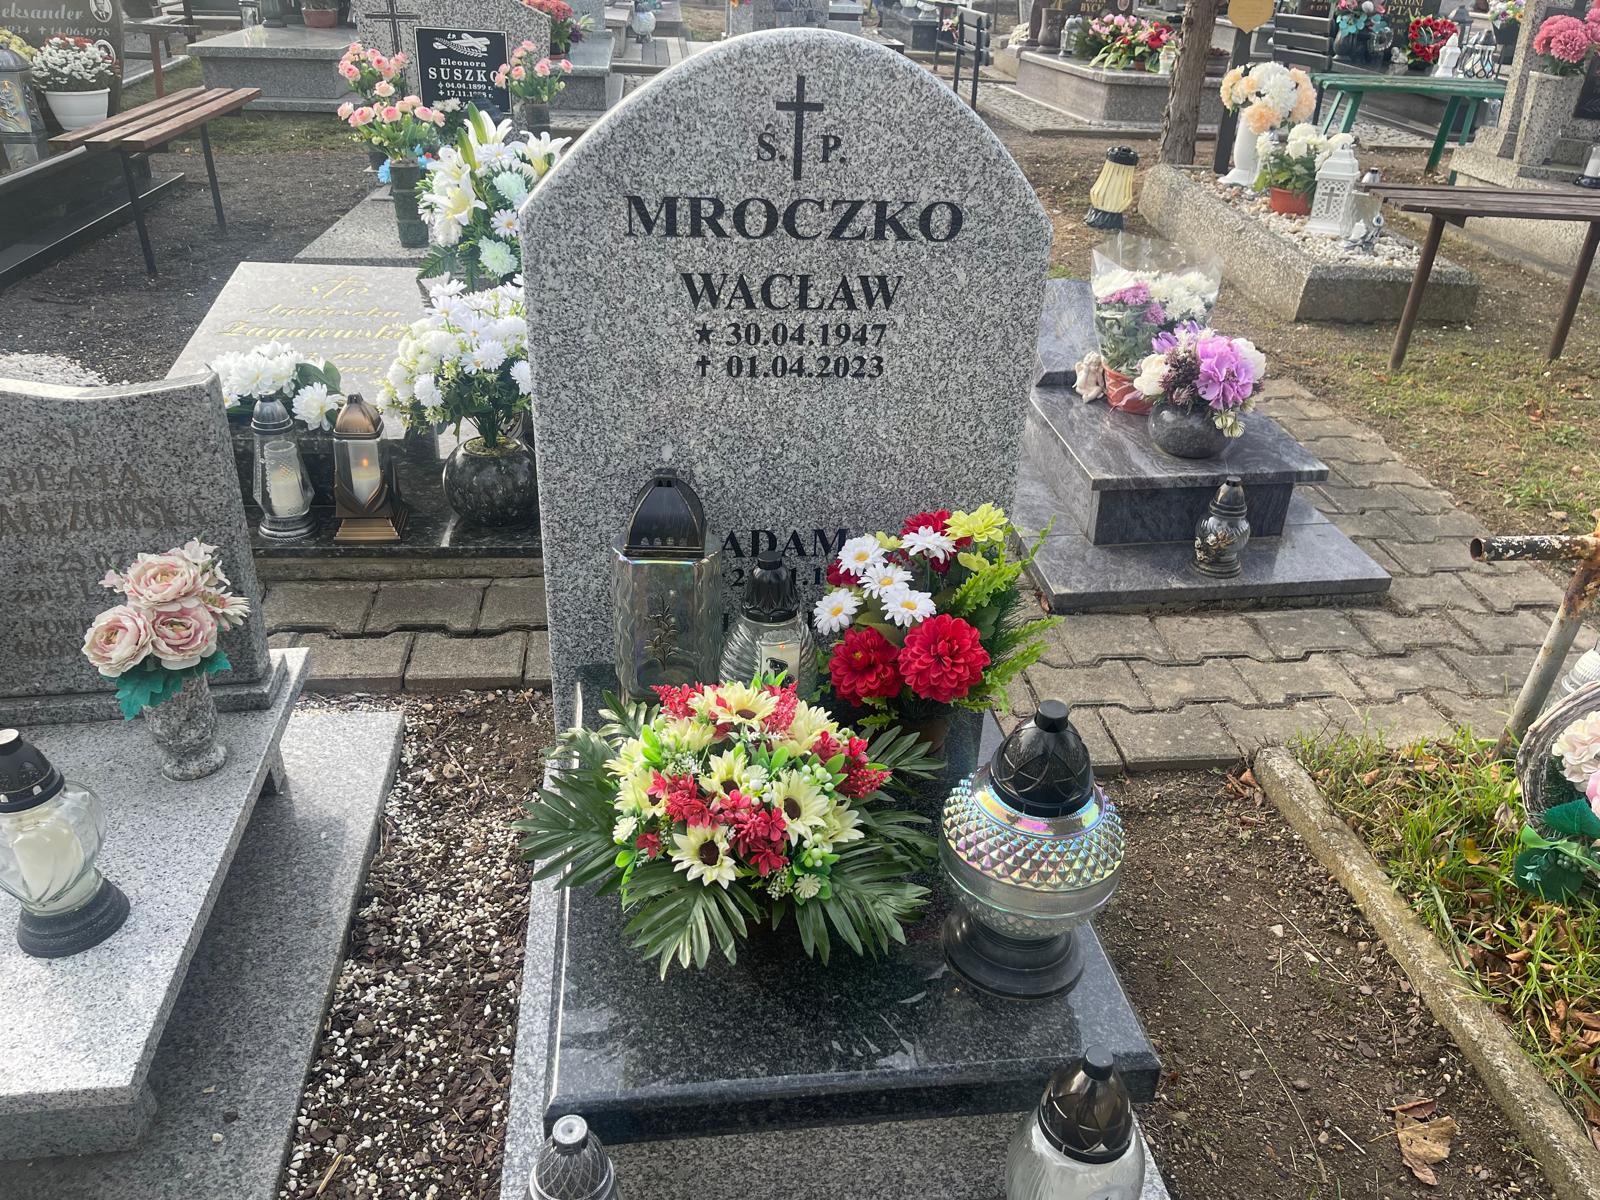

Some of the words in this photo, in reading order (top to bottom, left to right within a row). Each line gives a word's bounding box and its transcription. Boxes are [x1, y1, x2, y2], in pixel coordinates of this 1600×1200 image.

[440, 57, 487, 67] Eleonora
[626, 195, 964, 243] MROCZKO
[681, 272, 904, 313] WACŁAW
[726, 323, 888, 347] 30.04.1947
[726, 354, 885, 379] 01.04.2023
[722, 529, 850, 558] ADAM
